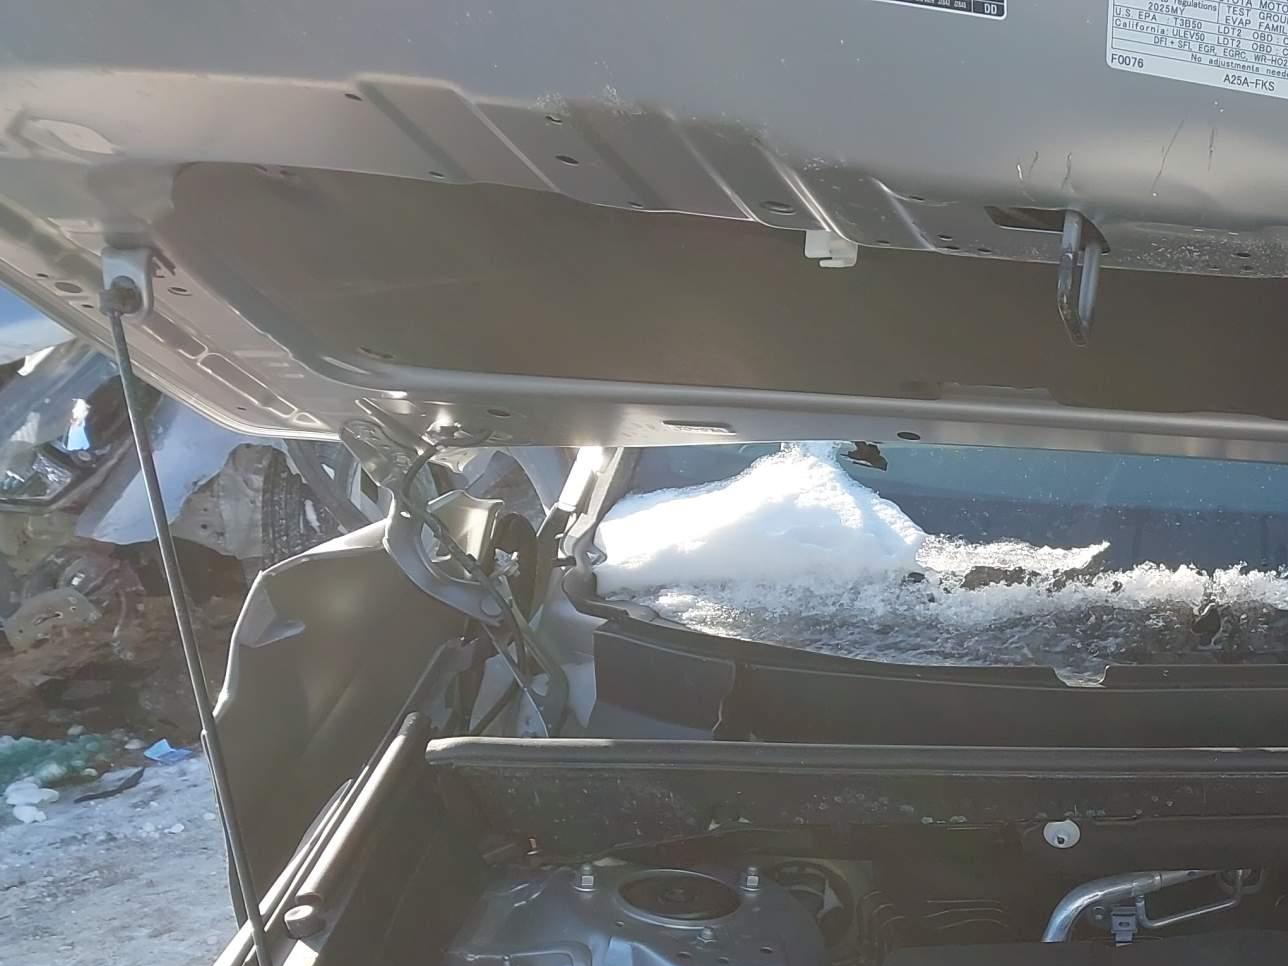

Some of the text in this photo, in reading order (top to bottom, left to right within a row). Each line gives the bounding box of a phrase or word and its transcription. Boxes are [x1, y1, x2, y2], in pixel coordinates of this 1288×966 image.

[984, 3, 997, 15] DD
[1148, 2, 1185, 16] 2025MY
[1227, 5, 1251, 18] TEST
[1138, 11, 1157, 22] EPA
[1173, 17, 1203, 30] T3B50
[1217, 26, 1242, 37] LDT2
[1252, 31, 1273, 43] OBD
[1225, 16, 1251, 27] EVAP
[1153, 35, 1168, 46] DFI
[1198, 42, 1217, 56] EGR,
[1223, 46, 1249, 61] EGRC,
[1172, 29, 1205, 42] ULEV50
[1217, 36, 1241, 48] LDT2
[1251, 42, 1273, 54] OBD
[1191, 53, 1202, 63] No
[1208, 58, 1260, 74] adjustments
[1223, 74, 1275, 92] A25A-FKS
